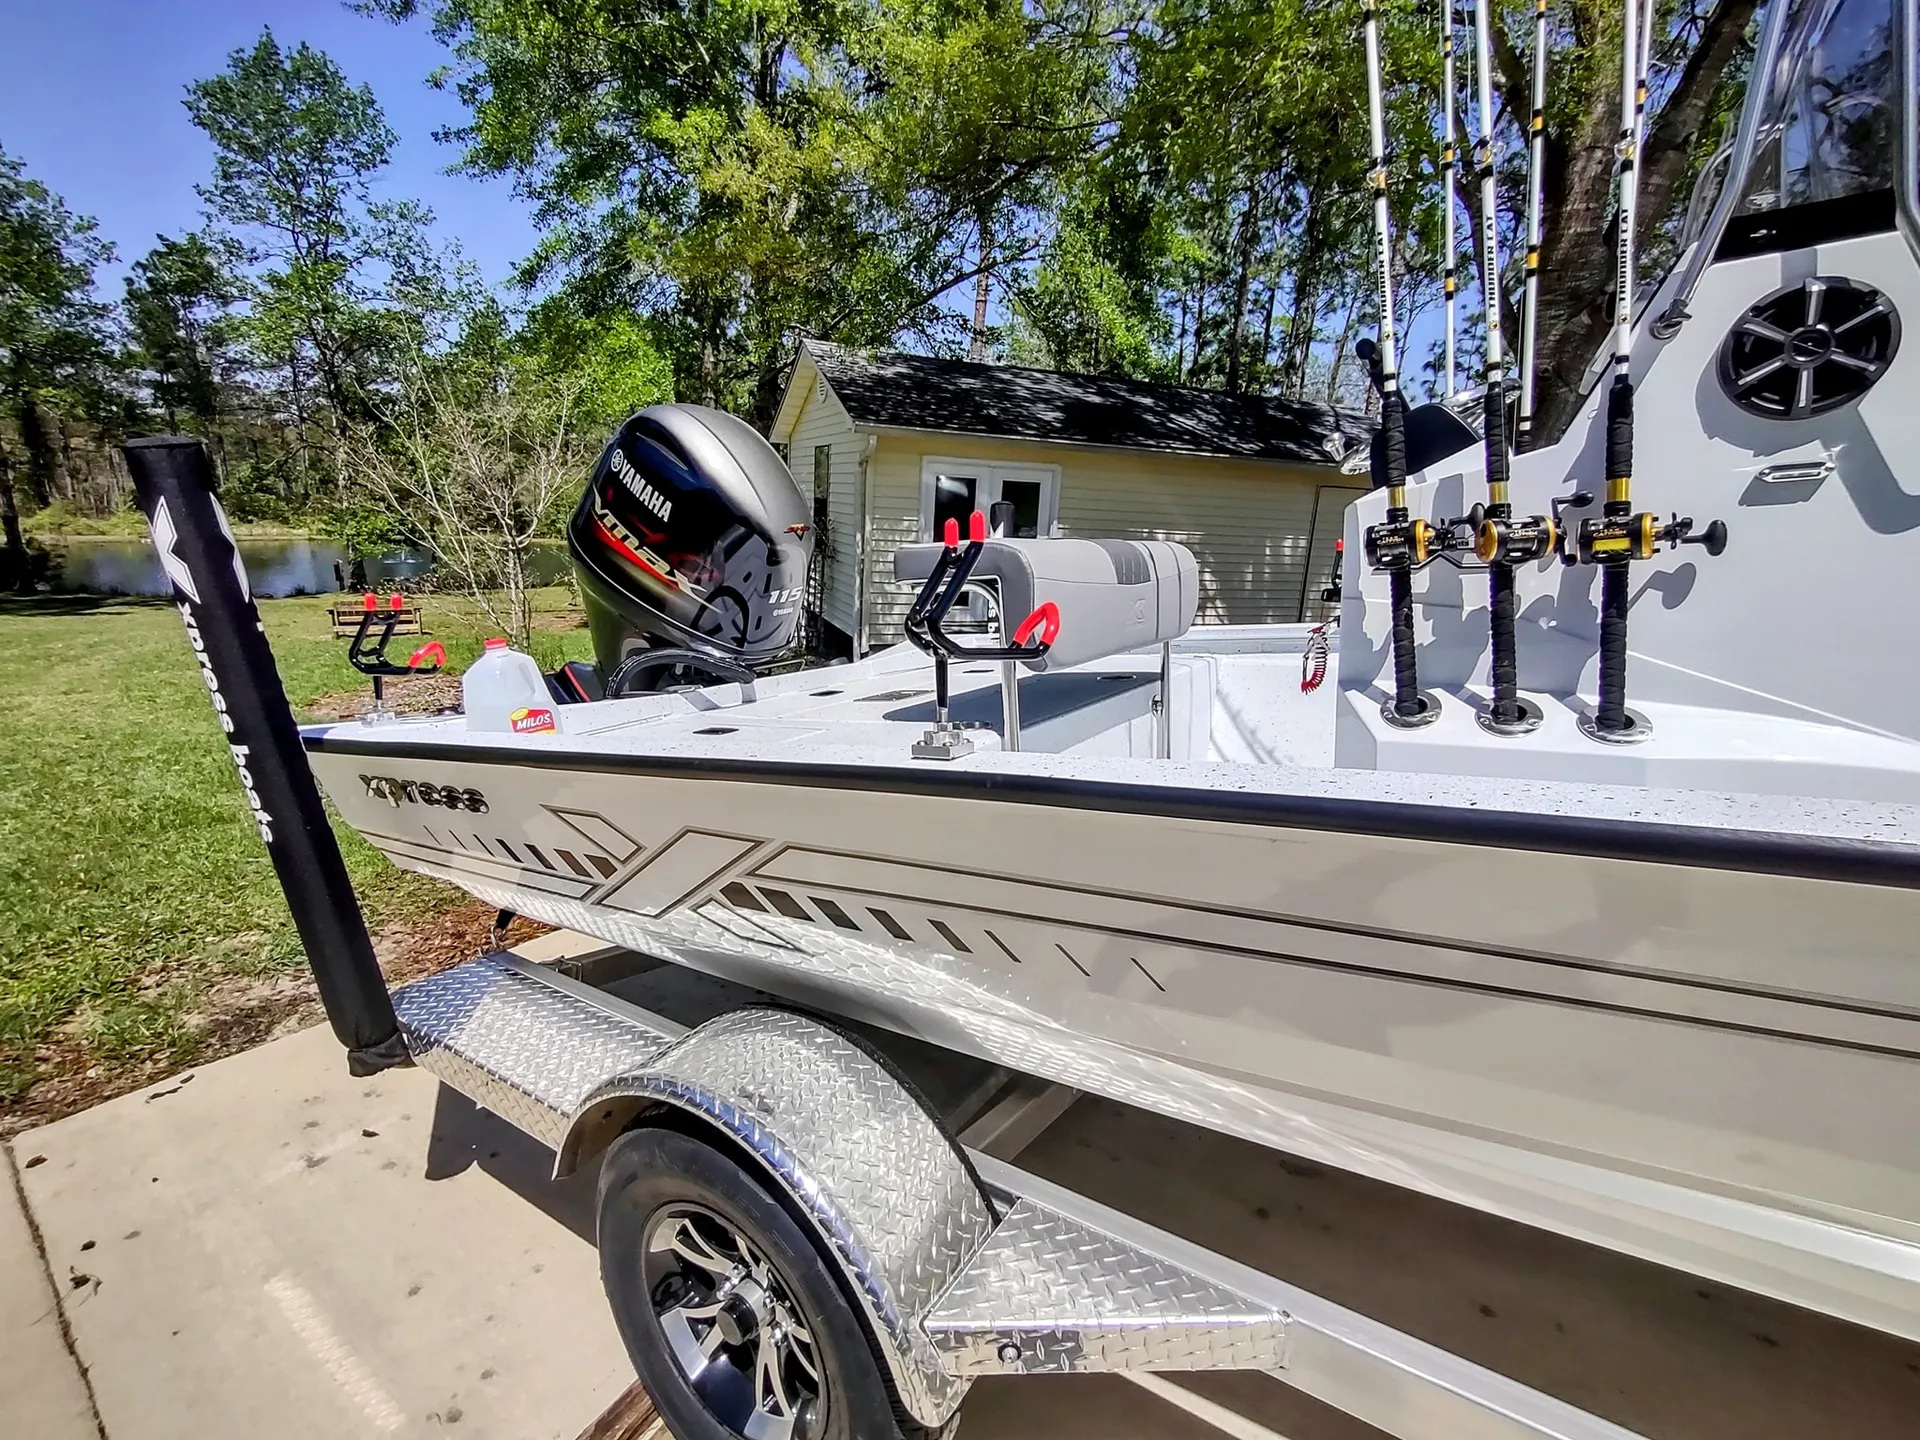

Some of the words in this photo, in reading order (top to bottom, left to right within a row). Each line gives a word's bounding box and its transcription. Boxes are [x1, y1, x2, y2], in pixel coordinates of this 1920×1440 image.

[1378, 260, 1388, 321] THUNDER
[1486, 245, 1497, 310] THUNDER
[1618, 238, 1628, 303] THUNDER
[619, 462, 674, 523] YAMAHA
[768, 586, 804, 604] 115
[176, 600, 235, 735] xpress
[229, 743, 274, 845] boats
[358, 773, 491, 815] xpress
